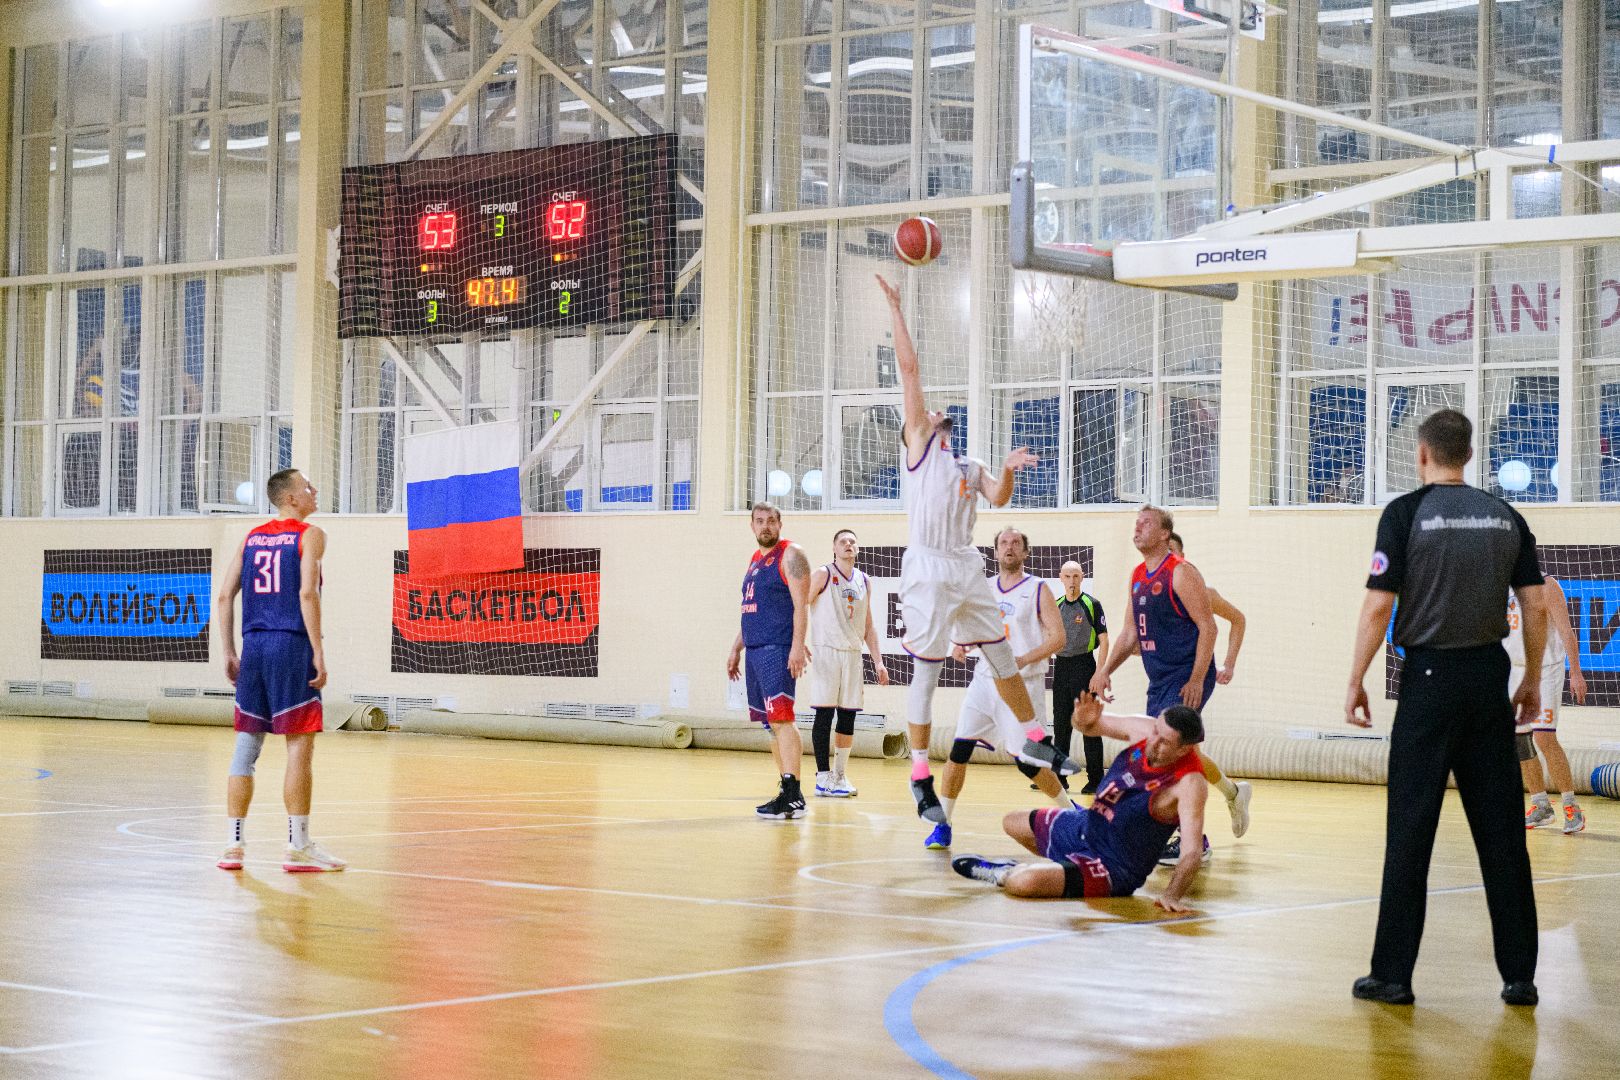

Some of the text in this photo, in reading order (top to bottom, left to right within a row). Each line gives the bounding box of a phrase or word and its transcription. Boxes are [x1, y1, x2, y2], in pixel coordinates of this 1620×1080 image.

[552, 190, 577, 202] СЧЕТ
[425, 202, 448, 214] СЧЕТ
[480, 202, 518, 214] ПЕРИОД
[424, 214, 456, 249] 53
[495, 215, 505, 237] 3
[551, 202, 585, 239] 52
[481, 265, 514, 277] ВРЕМЯ
[416, 289, 446, 300] ФОЛЫ
[550, 279, 580, 290] ФОЛЫ
[427, 300, 438, 322] 3
[559, 291, 570, 314] 2
[254, 549, 281, 594] 31
[51, 584, 200, 624] ВОЛЕЙБОЛ
[408, 589, 586, 622] БАСКЕТБОЛ
[1139, 613, 1147, 636] 9
